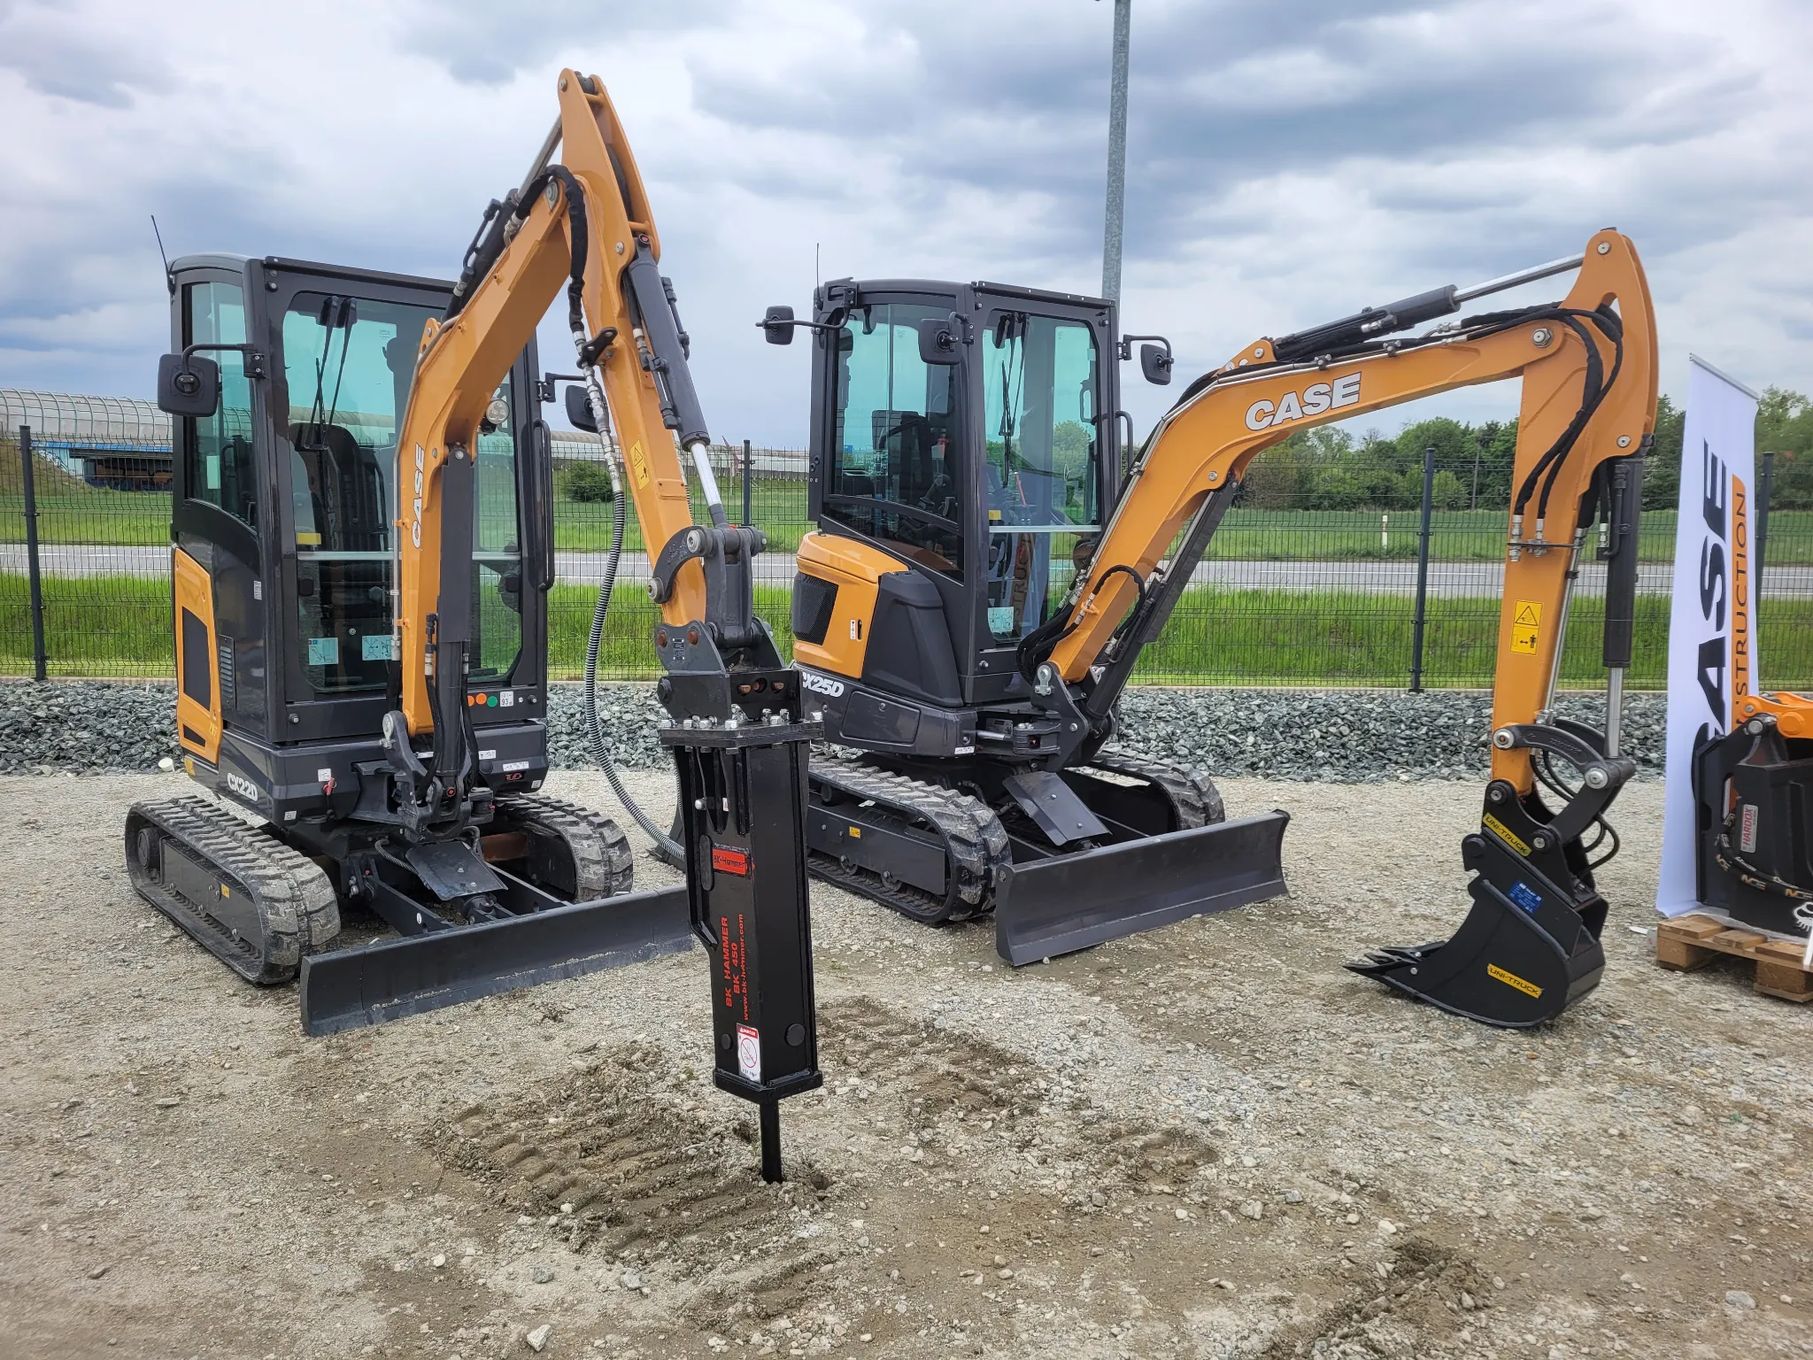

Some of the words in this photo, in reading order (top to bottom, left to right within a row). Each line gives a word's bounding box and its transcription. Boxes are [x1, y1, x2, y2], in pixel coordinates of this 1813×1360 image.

[1245, 371, 1362, 431] CASE
[412, 441, 425, 549] CASE
[227, 772, 258, 801] CX22D
[1485, 816, 1527, 853] UNI-TRUCK
[1743, 807, 1753, 846] HARDOX
[720, 916, 731, 980] HAMMER
[731, 942, 739, 967] 450
[725, 987, 733, 1008] BK
[733, 974, 741, 994] BK
[1490, 968, 1539, 996] UNI-TRUCK
